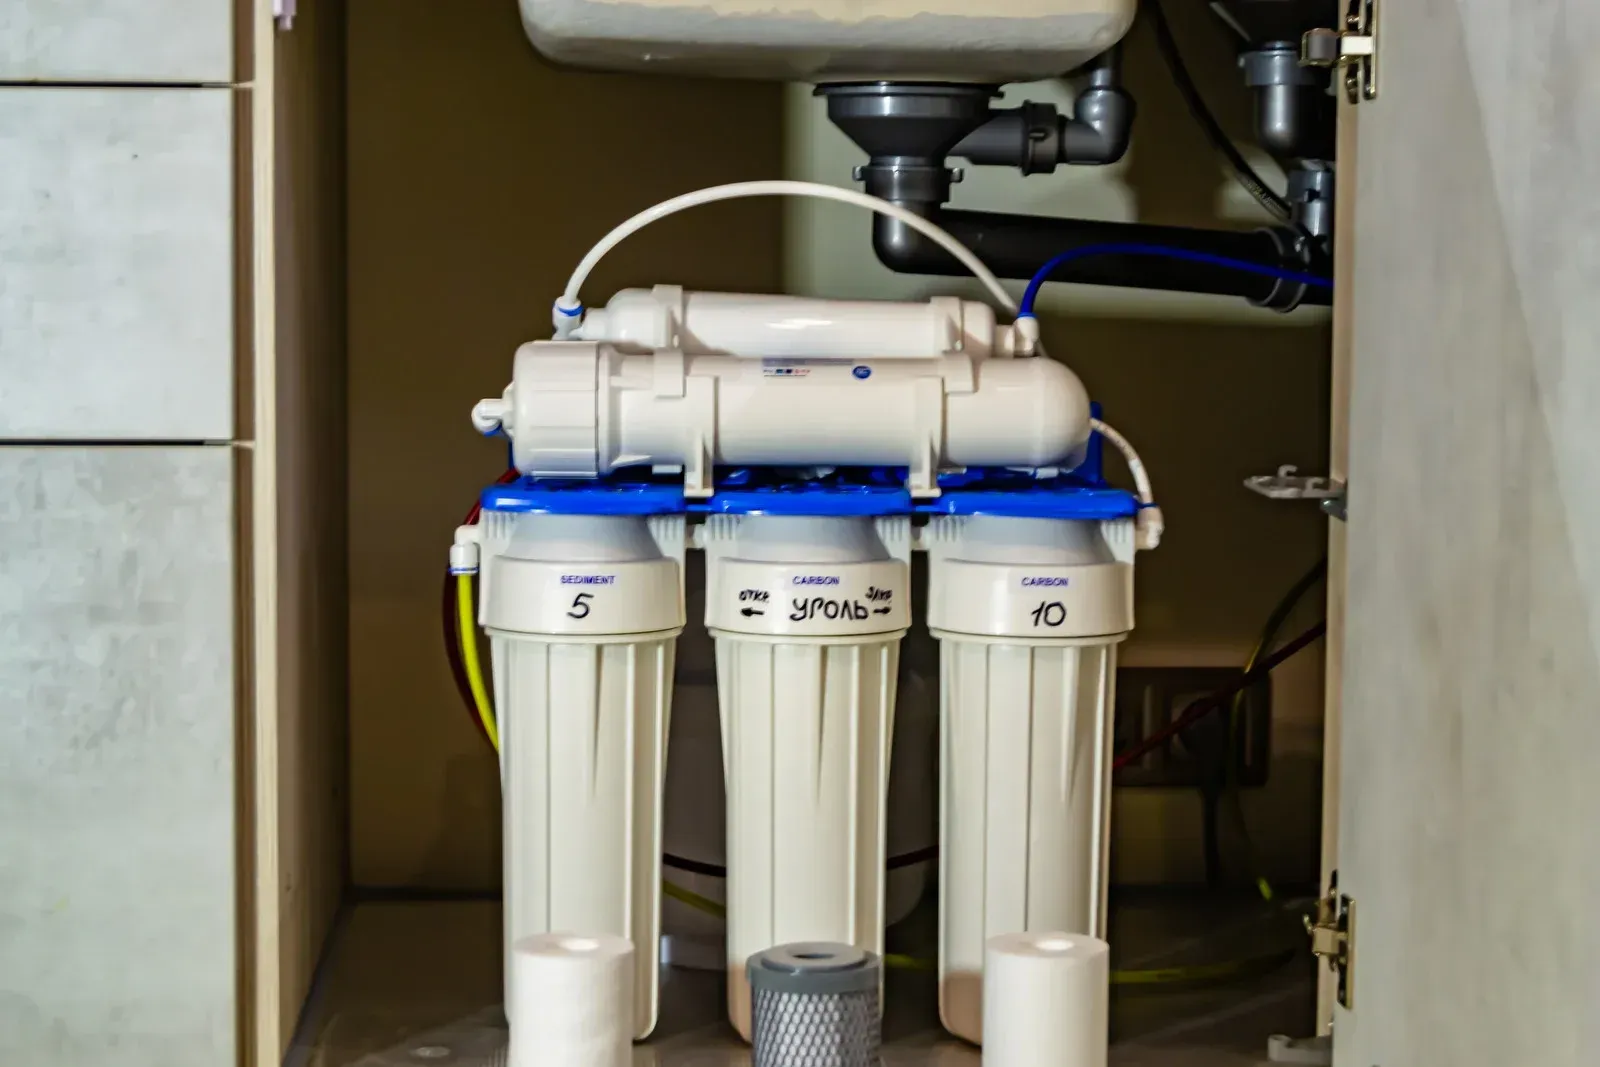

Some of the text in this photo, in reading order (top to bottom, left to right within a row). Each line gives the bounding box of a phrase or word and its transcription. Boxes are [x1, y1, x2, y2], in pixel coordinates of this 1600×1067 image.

[560, 574, 615, 585] SEDIMENT
[792, 575, 840, 586] CARBON
[1021, 576, 1069, 587] CARBON
[565, 592, 595, 620] 5
[1031, 600, 1067, 628] 10
